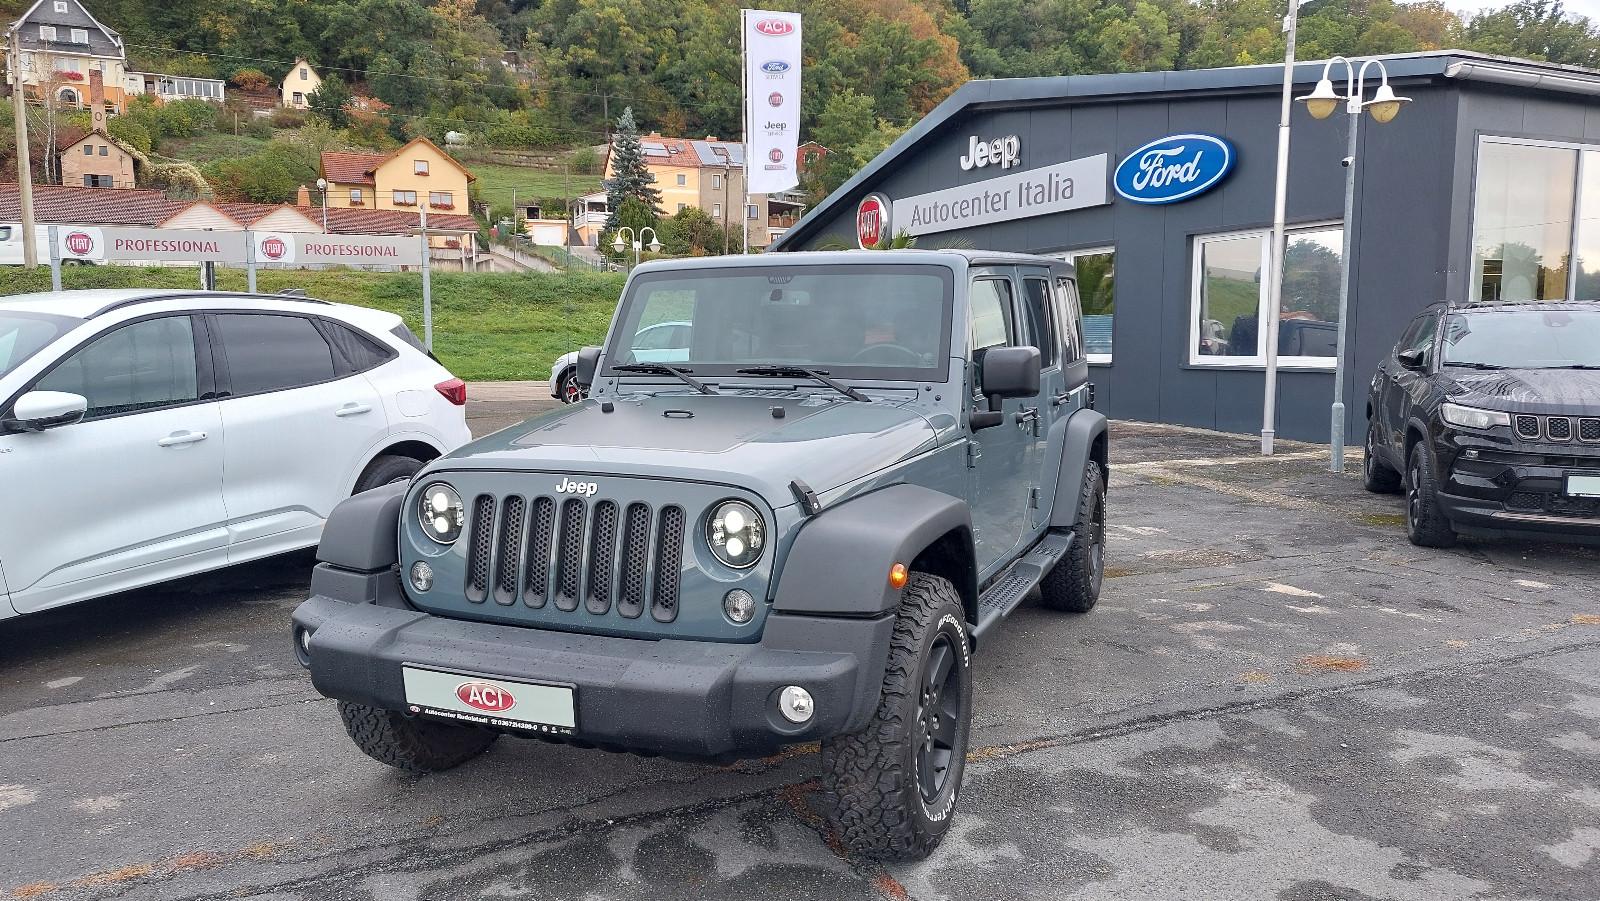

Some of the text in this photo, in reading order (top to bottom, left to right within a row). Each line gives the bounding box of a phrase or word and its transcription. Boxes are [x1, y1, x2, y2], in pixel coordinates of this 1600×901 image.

[763, 21, 787, 33] ACI
[767, 63, 784, 71] Ford
[764, 121, 787, 131] Jeep
[960, 134, 1021, 171] Jeep
[1132, 145, 1204, 191] Ford
[910, 172, 1075, 228] Autocenter Italia
[71, 237, 221, 253] FIAT PROFESSIONAL
[266, 242, 399, 257] FIAT PROFESSIONAL
[555, 477, 598, 498] Jeep
[468, 685, 504, 708] ACI
